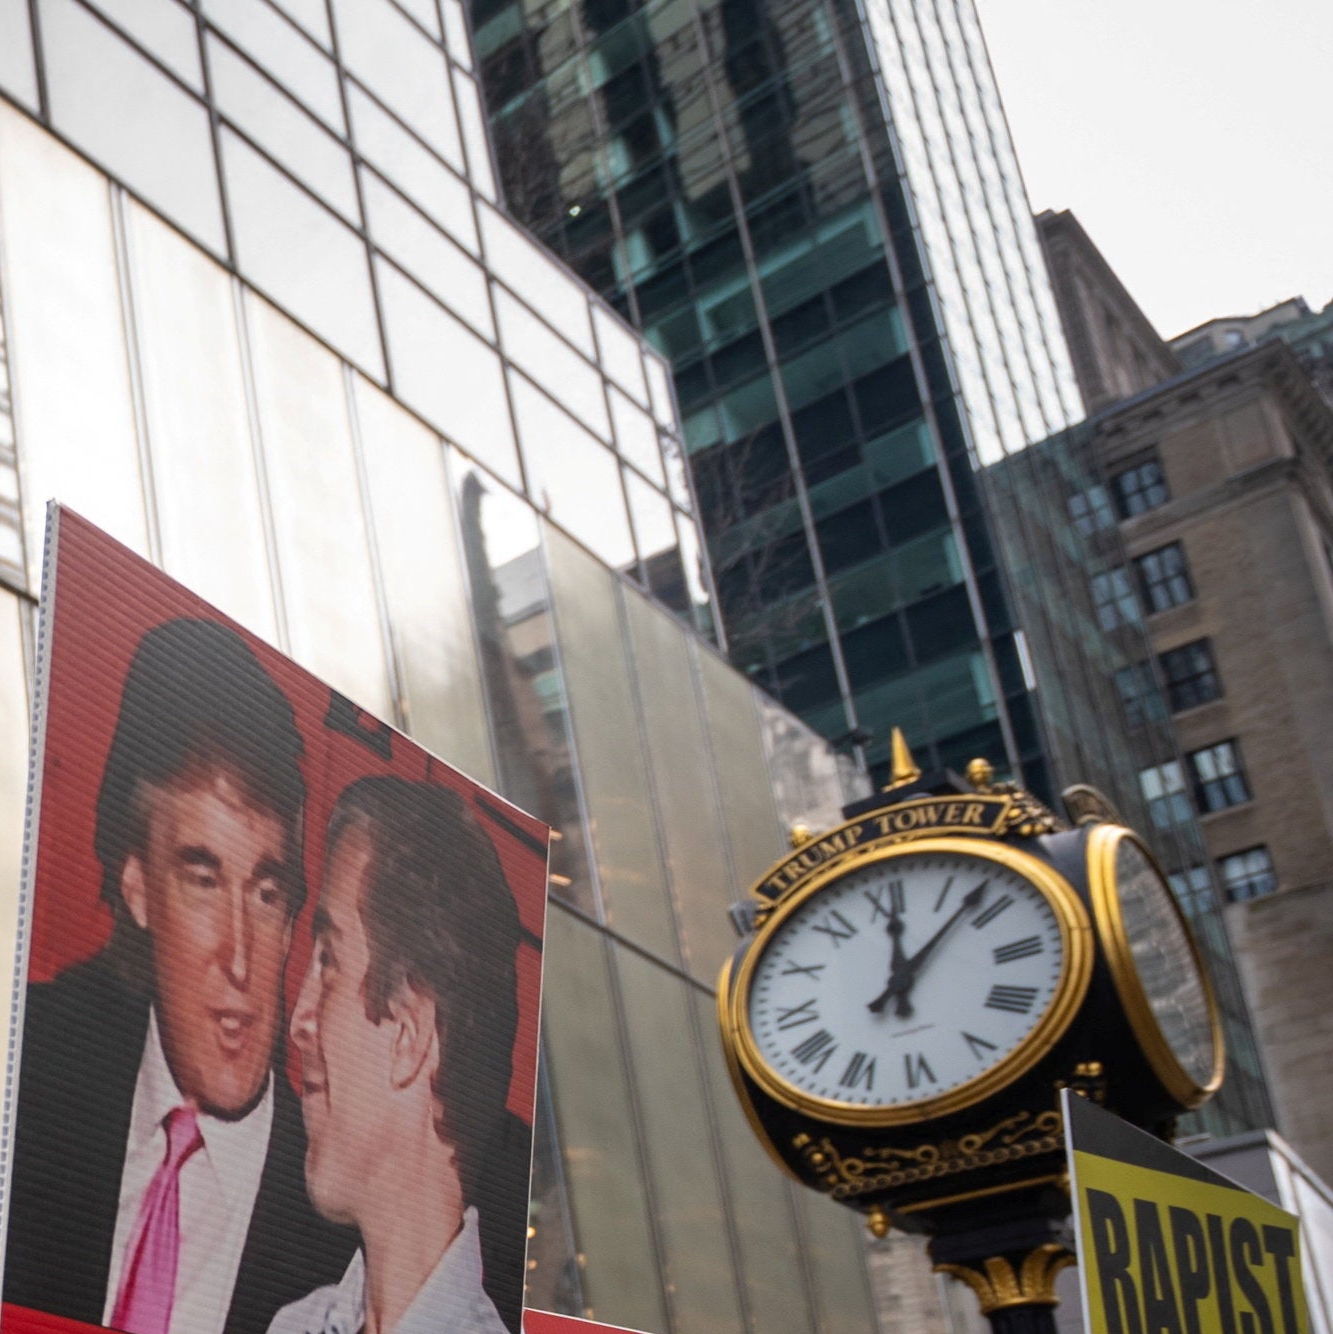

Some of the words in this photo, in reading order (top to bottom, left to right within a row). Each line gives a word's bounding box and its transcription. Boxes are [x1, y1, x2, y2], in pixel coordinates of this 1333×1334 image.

[766, 823, 864, 893] TRUMP
[875, 801, 987, 836] TOWER
[992, 934, 1045, 966] III
